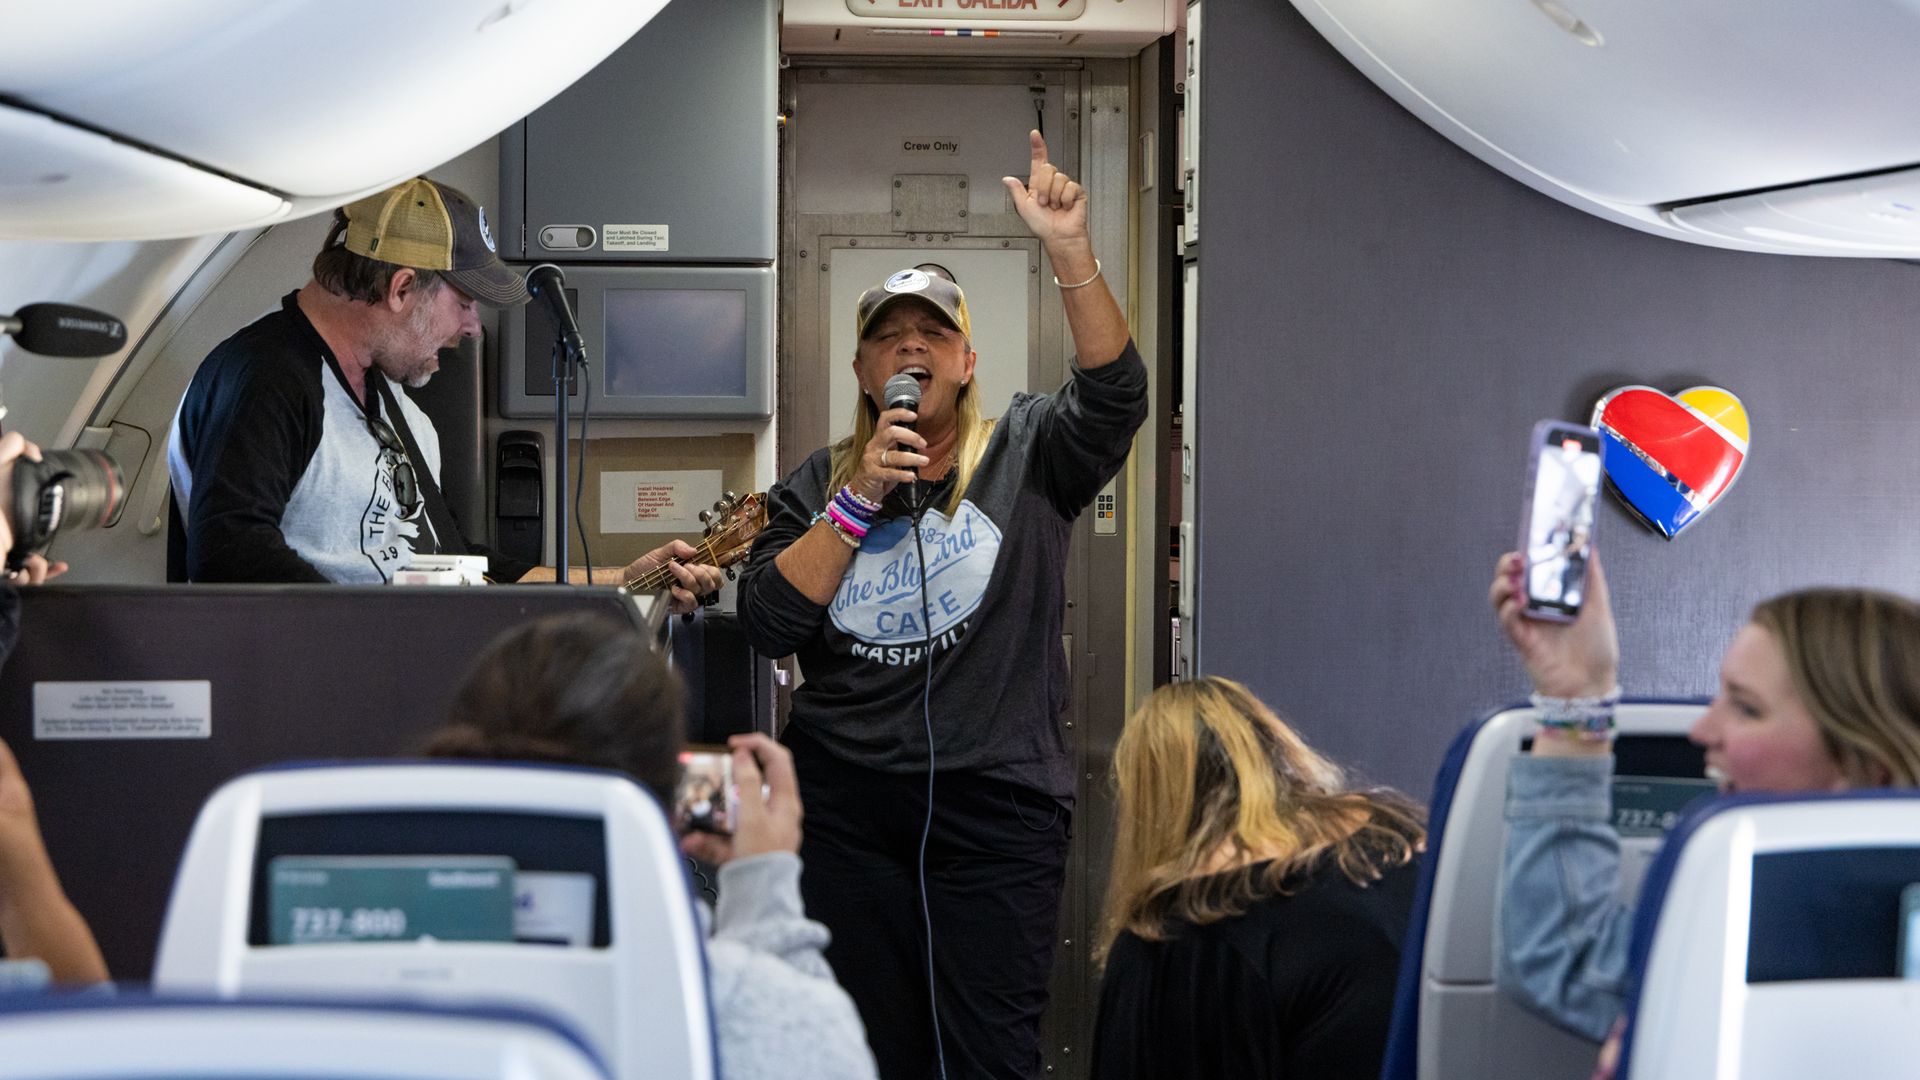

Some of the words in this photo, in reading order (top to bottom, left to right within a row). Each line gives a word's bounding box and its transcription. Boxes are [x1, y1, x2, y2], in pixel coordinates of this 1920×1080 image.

[903, 141, 930, 151] Crew
[933, 141, 958, 153] Only
[369, 496, 391, 539] THE
[380, 546, 399, 562] 19
[835, 571, 875, 612] The
[876, 589, 961, 634] CAFE
